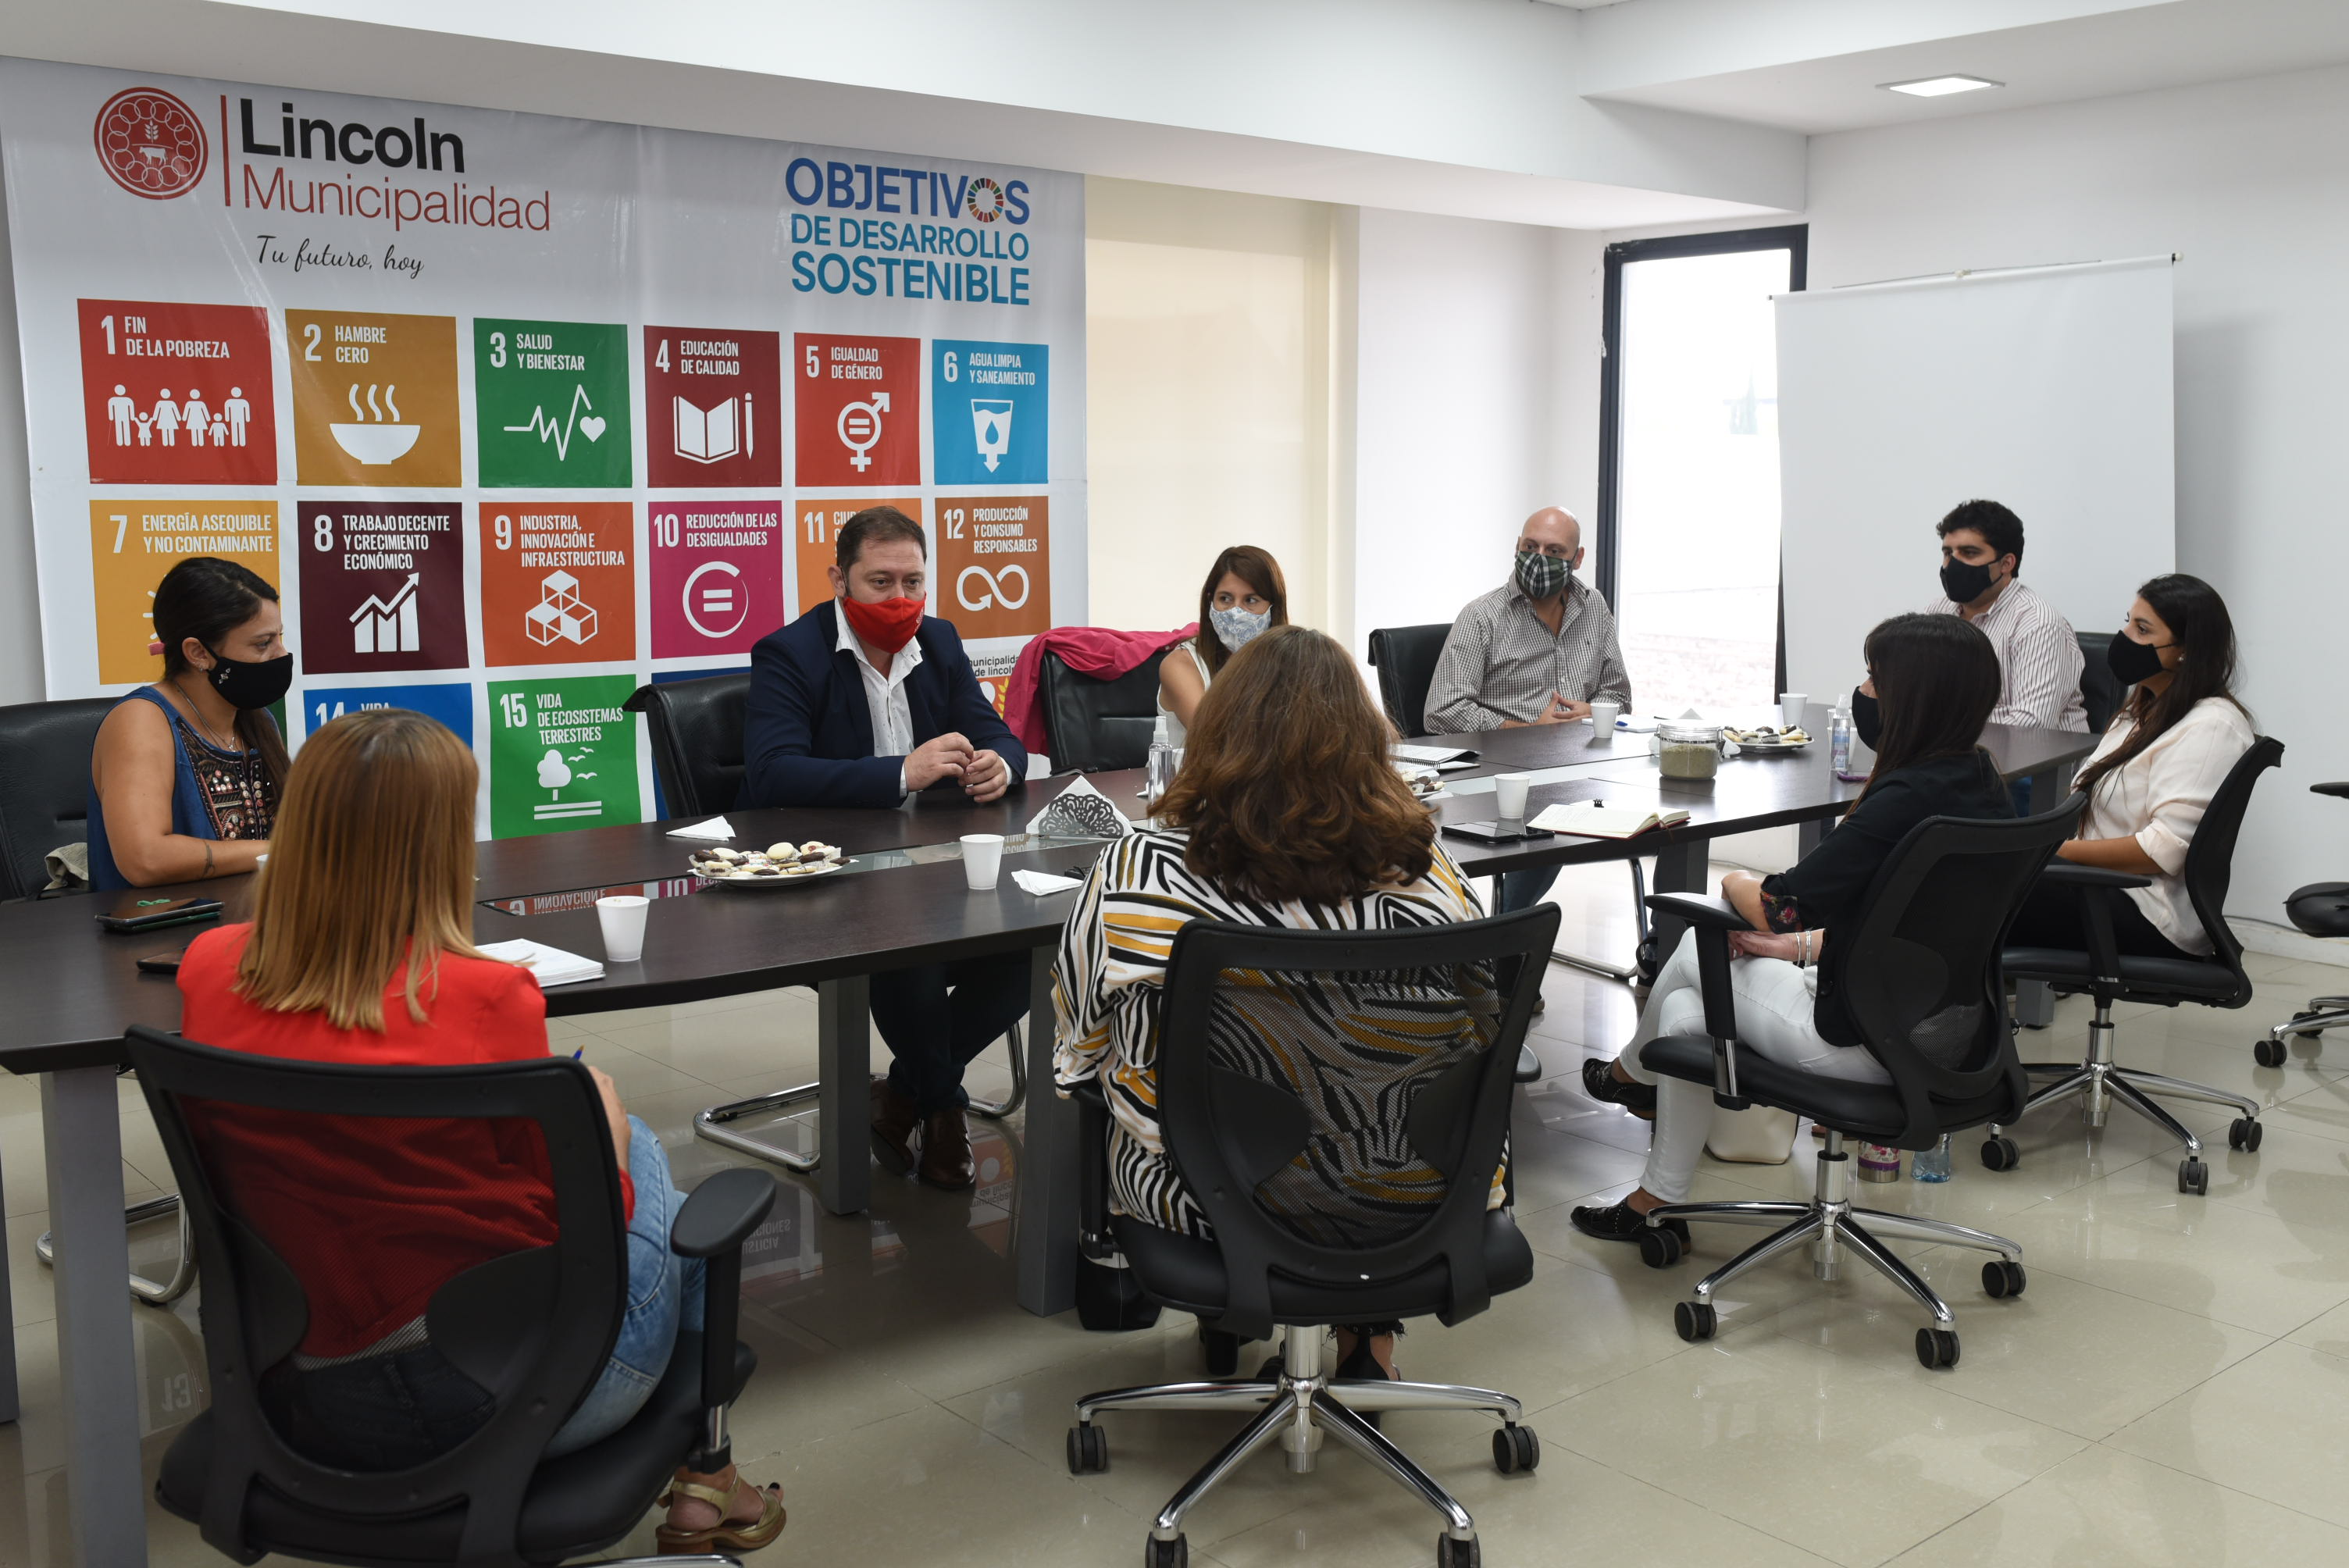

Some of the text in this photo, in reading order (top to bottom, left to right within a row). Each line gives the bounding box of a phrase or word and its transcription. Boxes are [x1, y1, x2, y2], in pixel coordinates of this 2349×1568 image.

[240, 98, 465, 173] Lincoln
[243, 164, 549, 231] Municipalidad
[786, 158, 1029, 225] OBJETIVOS
[791, 213, 1029, 262] DE DESARROLLO
[257, 235, 425, 279] Tu futuro, hoy
[792, 251, 1029, 305] SOSTENIBLE
[124, 316, 147, 333] FIN
[101, 315, 116, 355] 1
[304, 323, 322, 362] 2
[334, 325, 387, 344] HAMBRE
[516, 333, 552, 350] SALUD
[126, 338, 230, 358] DE LA POBREZA
[335, 347, 369, 364] CERO
[490, 332, 507, 368] 3
[655, 339, 670, 372] 4
[680, 340, 739, 357] EDUCACIÓN
[831, 347, 879, 362] IGUALDAD
[517, 353, 585, 371] Y BIENESTAR
[681, 359, 740, 376] DE CALIDAD
[806, 345, 819, 378] 5
[943, 351, 958, 383] 6
[969, 353, 1021, 368] AGUA LIMPIA
[831, 363, 882, 380] DE GÉNERO
[969, 370, 1035, 386] Y SANEAMIENTO
[142, 512, 272, 533] ENERGÍA ASEQUIBLE
[342, 515, 450, 531] TRABAJO DECENTE
[520, 515, 582, 531] INDUSTRIA,
[686, 511, 777, 529] REDUCCIÓN DE LAS
[944, 508, 964, 539] 12
[973, 506, 1028, 522] PRODUCCIÓN
[109, 515, 127, 554] 7
[314, 515, 333, 552] 8
[494, 515, 512, 551] 9
[654, 514, 679, 547] 10
[804, 511, 825, 543] 11
[974, 523, 1023, 537] Y CONSUMO
[143, 536, 273, 554] Y NO CONTAMINANTE
[344, 534, 429, 551] Y CRECIMIENTO
[521, 532, 595, 549] INNOVACIÓN E
[686, 532, 768, 547] DESIGUALDADES
[974, 539, 1037, 554] RESPONSABLES
[344, 551, 413, 570] ECONÓMICO
[521, 551, 625, 568] INFRAESTRUCTURA
[975, 668, 986, 676] de
[500, 693, 527, 728] 15
[536, 693, 562, 709] VIDA
[538, 707, 623, 727] DE ECOSISTEMAS
[540, 726, 601, 745] TERRESTRES
